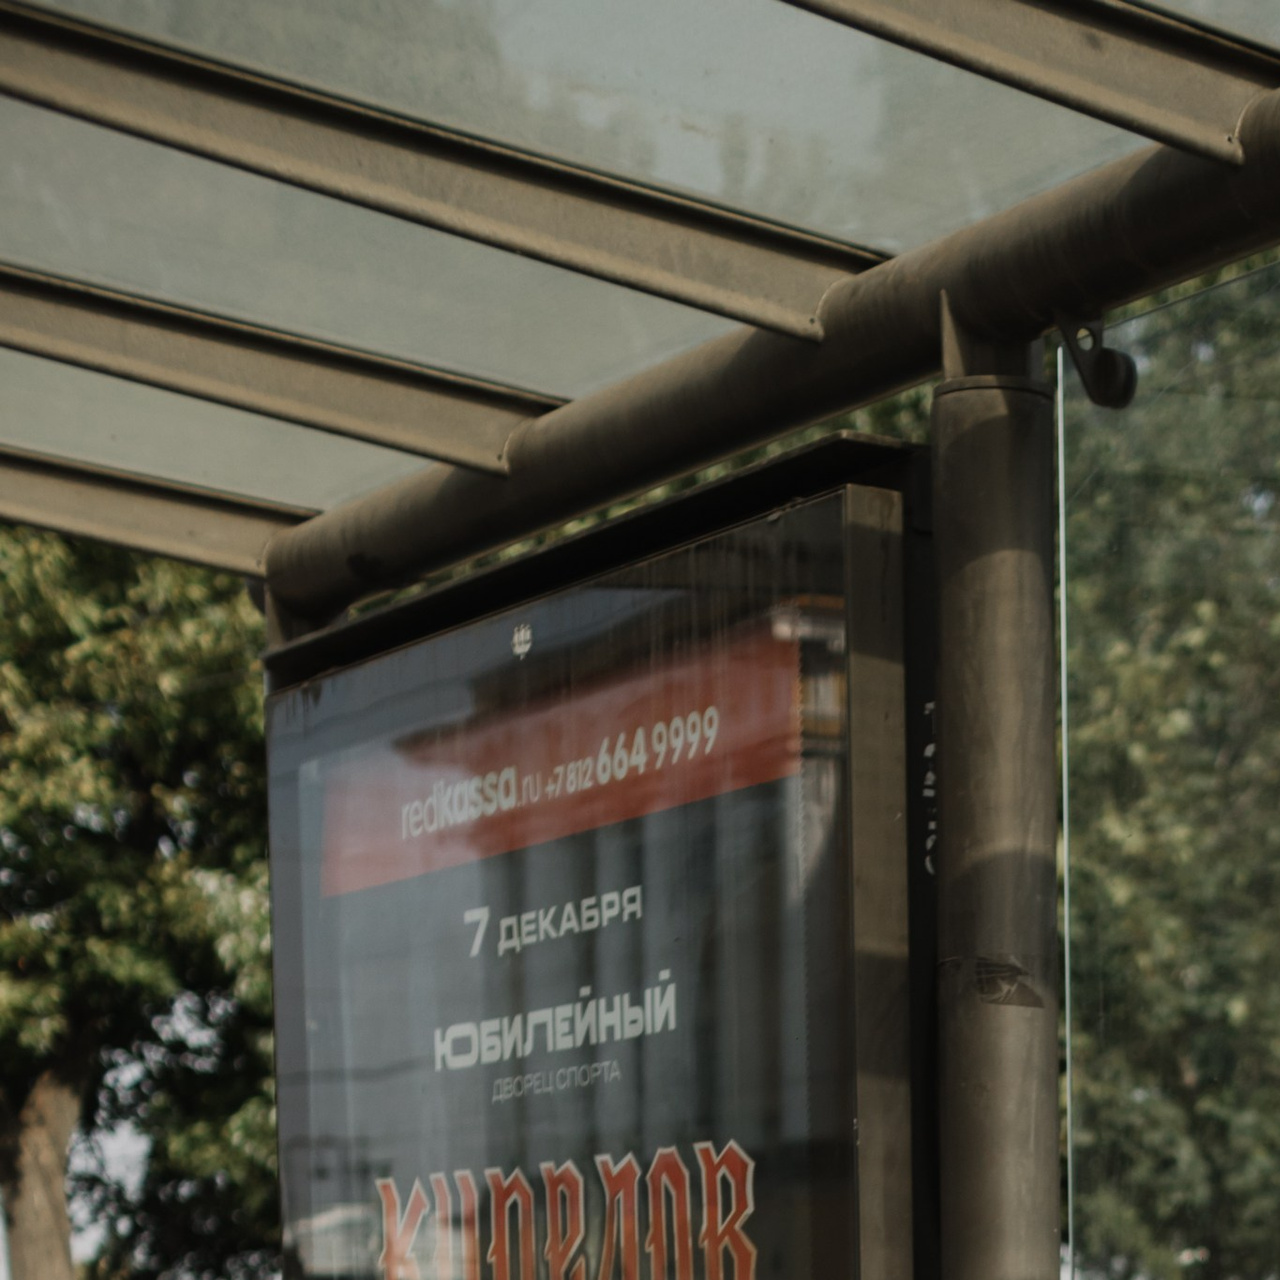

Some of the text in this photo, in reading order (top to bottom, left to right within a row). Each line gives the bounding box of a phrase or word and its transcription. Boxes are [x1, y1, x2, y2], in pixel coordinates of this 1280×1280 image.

[402, 765, 541, 839] redkassa.ru
[651, 705, 720, 770] 9999
[464, 884, 643, 958] 7 ДЕКАБРЯ
[434, 968, 677, 1072] ЮБИЛЕЙНЫЙ
[491, 1059, 623, 1104] ДВОРЕЦ СПОРТА
